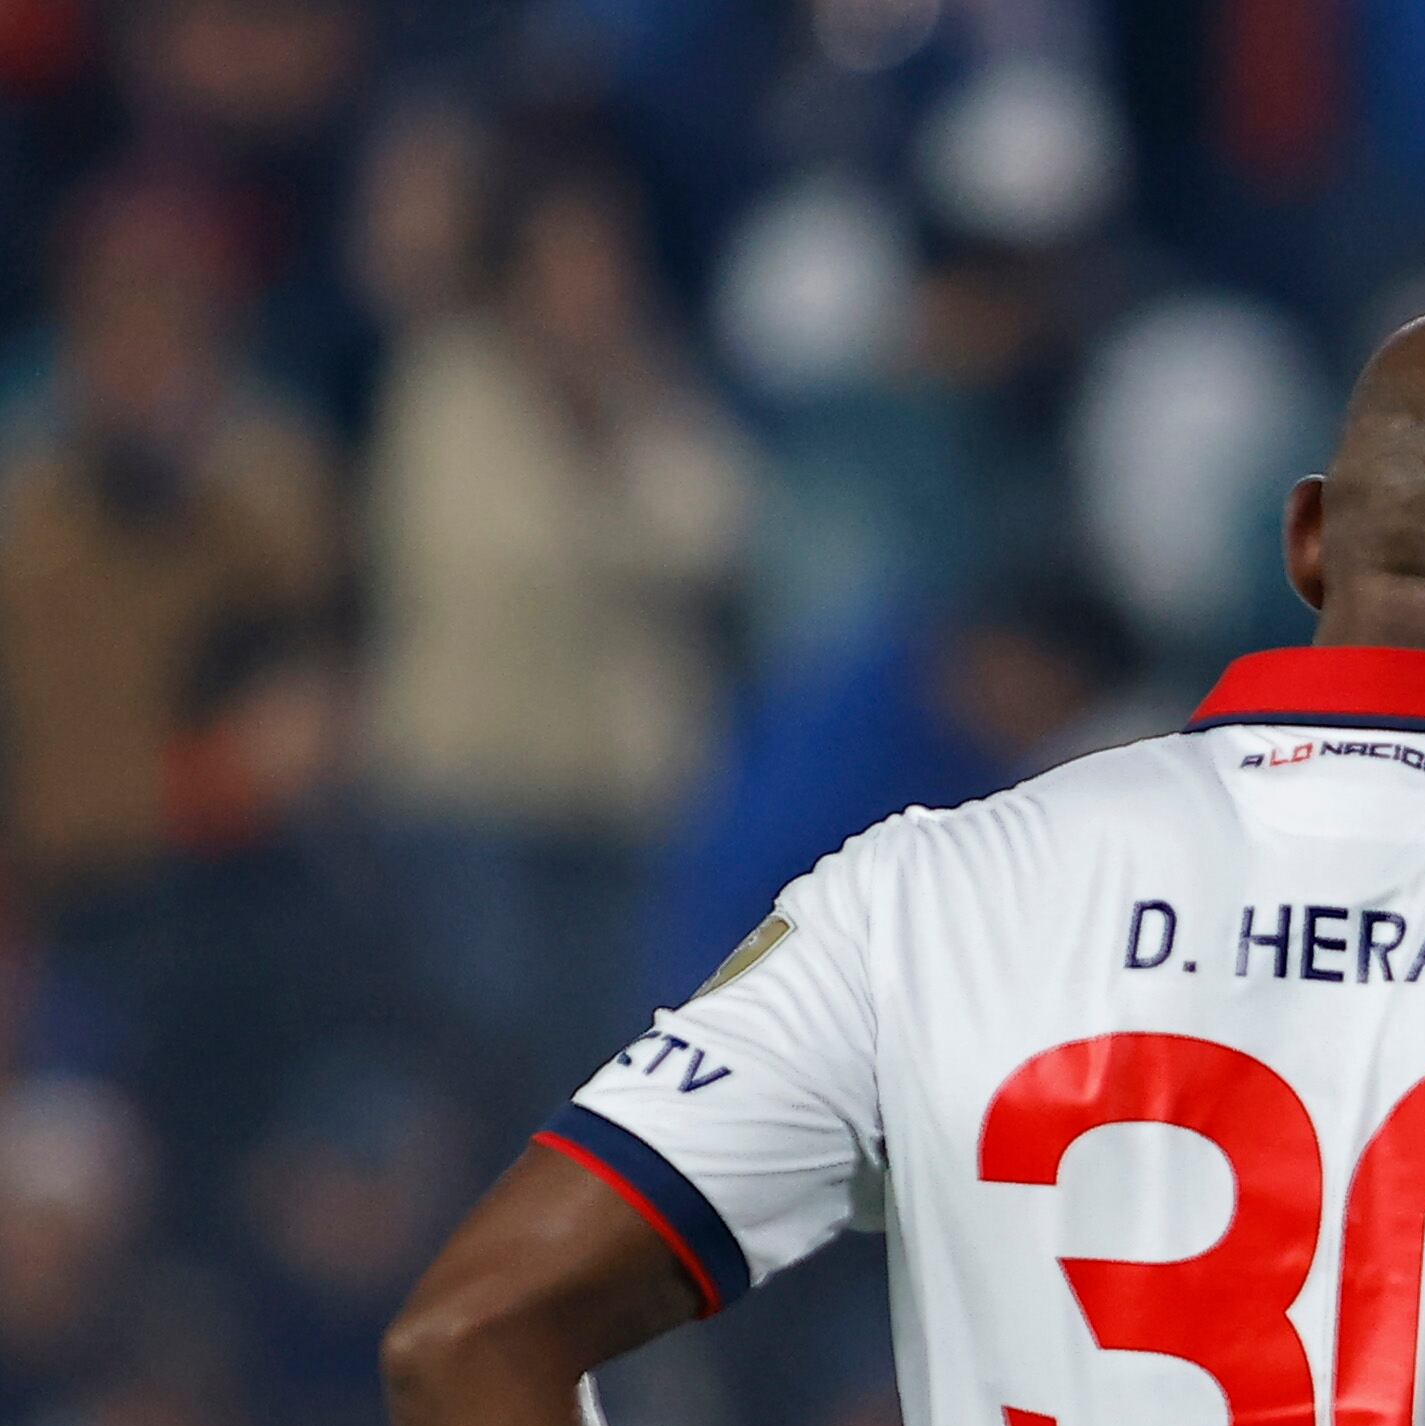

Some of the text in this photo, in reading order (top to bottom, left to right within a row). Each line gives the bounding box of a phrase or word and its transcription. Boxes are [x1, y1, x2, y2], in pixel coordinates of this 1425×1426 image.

[1240, 754, 1265, 768] A
[1269, 743, 1314, 767] LO
[1124, 900, 1197, 972] D.
